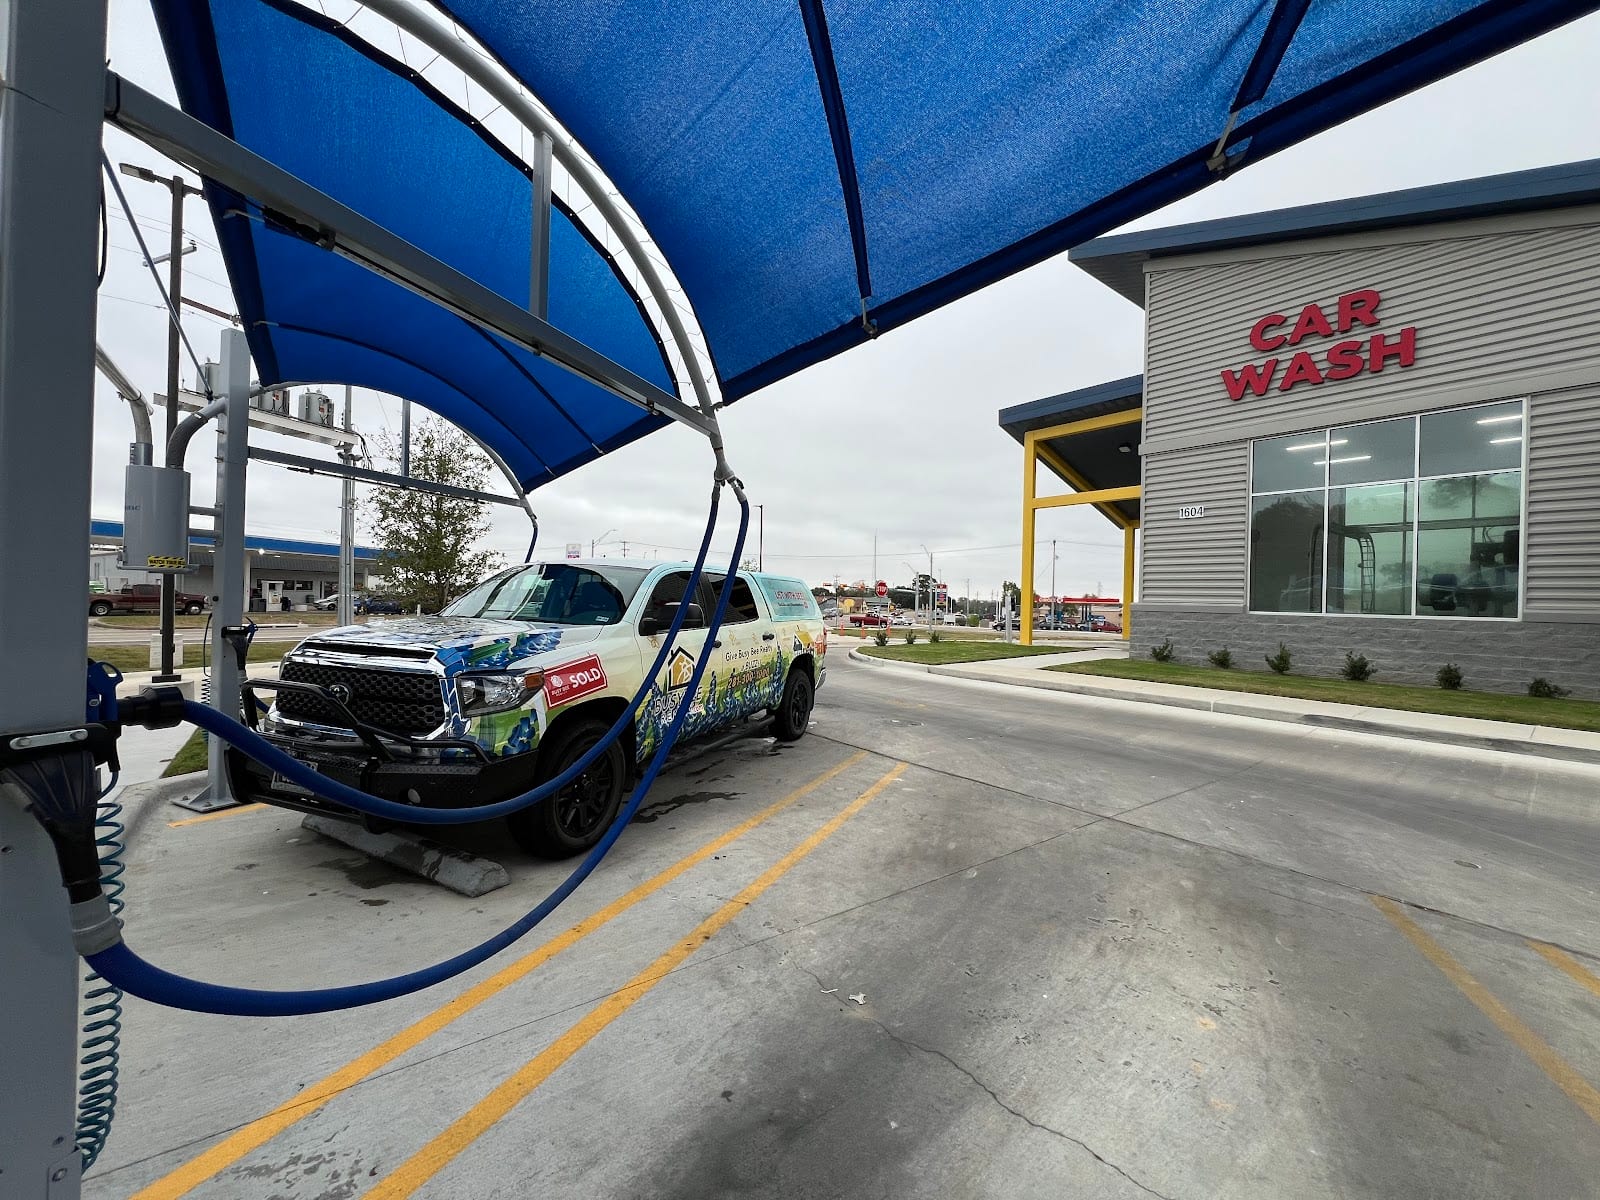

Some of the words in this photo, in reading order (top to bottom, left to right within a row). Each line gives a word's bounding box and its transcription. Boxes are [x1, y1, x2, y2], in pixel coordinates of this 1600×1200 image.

[1249, 289, 1381, 351] CAR
[1220, 326, 1416, 401] WASH
[1180, 506, 1203, 517] 1604
[725, 651, 738, 662] Give
[738, 649, 749, 660] Busy
[750, 647, 759, 656] Bee
[569, 668, 601, 688] SOLD
[655, 691, 686, 715] BUSY
